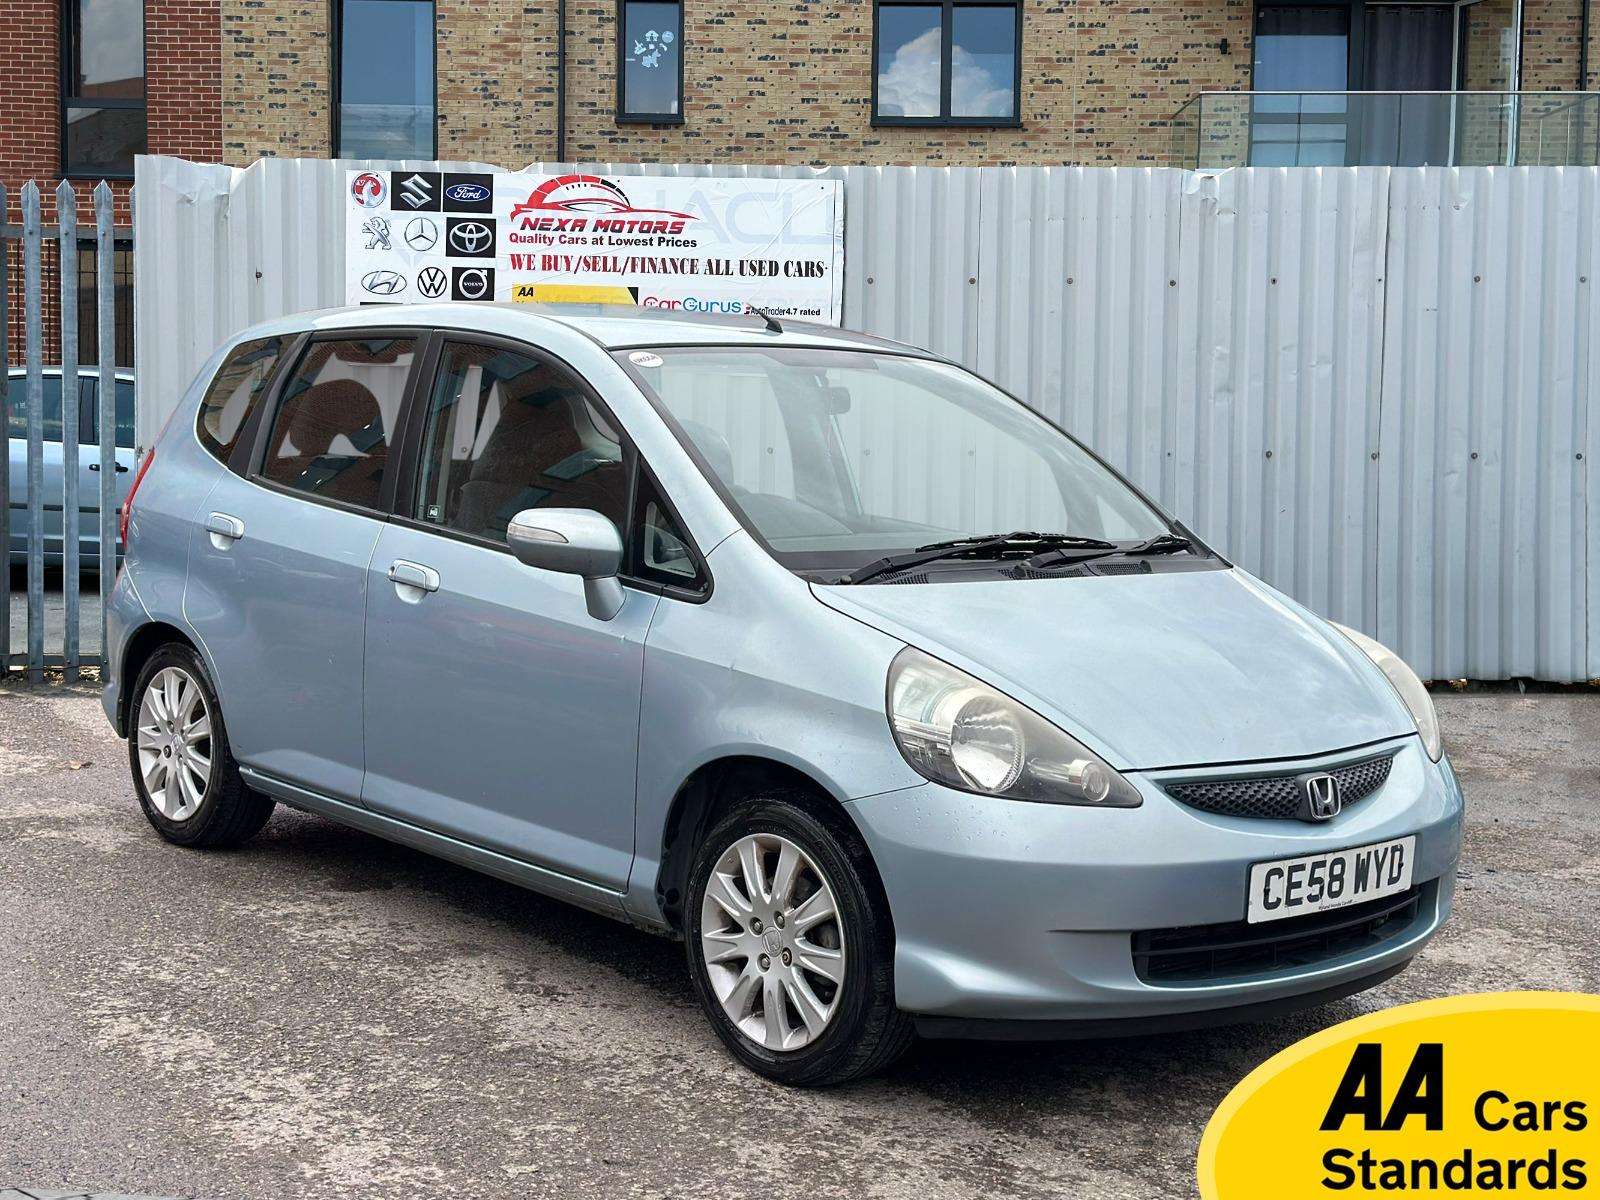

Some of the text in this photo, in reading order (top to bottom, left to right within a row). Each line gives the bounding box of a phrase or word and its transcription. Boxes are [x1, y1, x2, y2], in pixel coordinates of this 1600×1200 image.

[453, 186, 481, 199] Ford
[520, 217, 686, 235] NEXA MOTORS
[509, 232, 698, 248] Quality Cars at Lowest Prices
[509, 253, 536, 271] WE
[541, 254, 700, 275] BUY/SELL/FINANCE
[704, 258, 734, 276] ALL
[739, 259, 780, 277] USED
[517, 286, 534, 297] AA
[643, 296, 742, 314] CarGurus
[800, 308, 821, 316] rated
[1263, 843, 1405, 911] CE58 WYD
